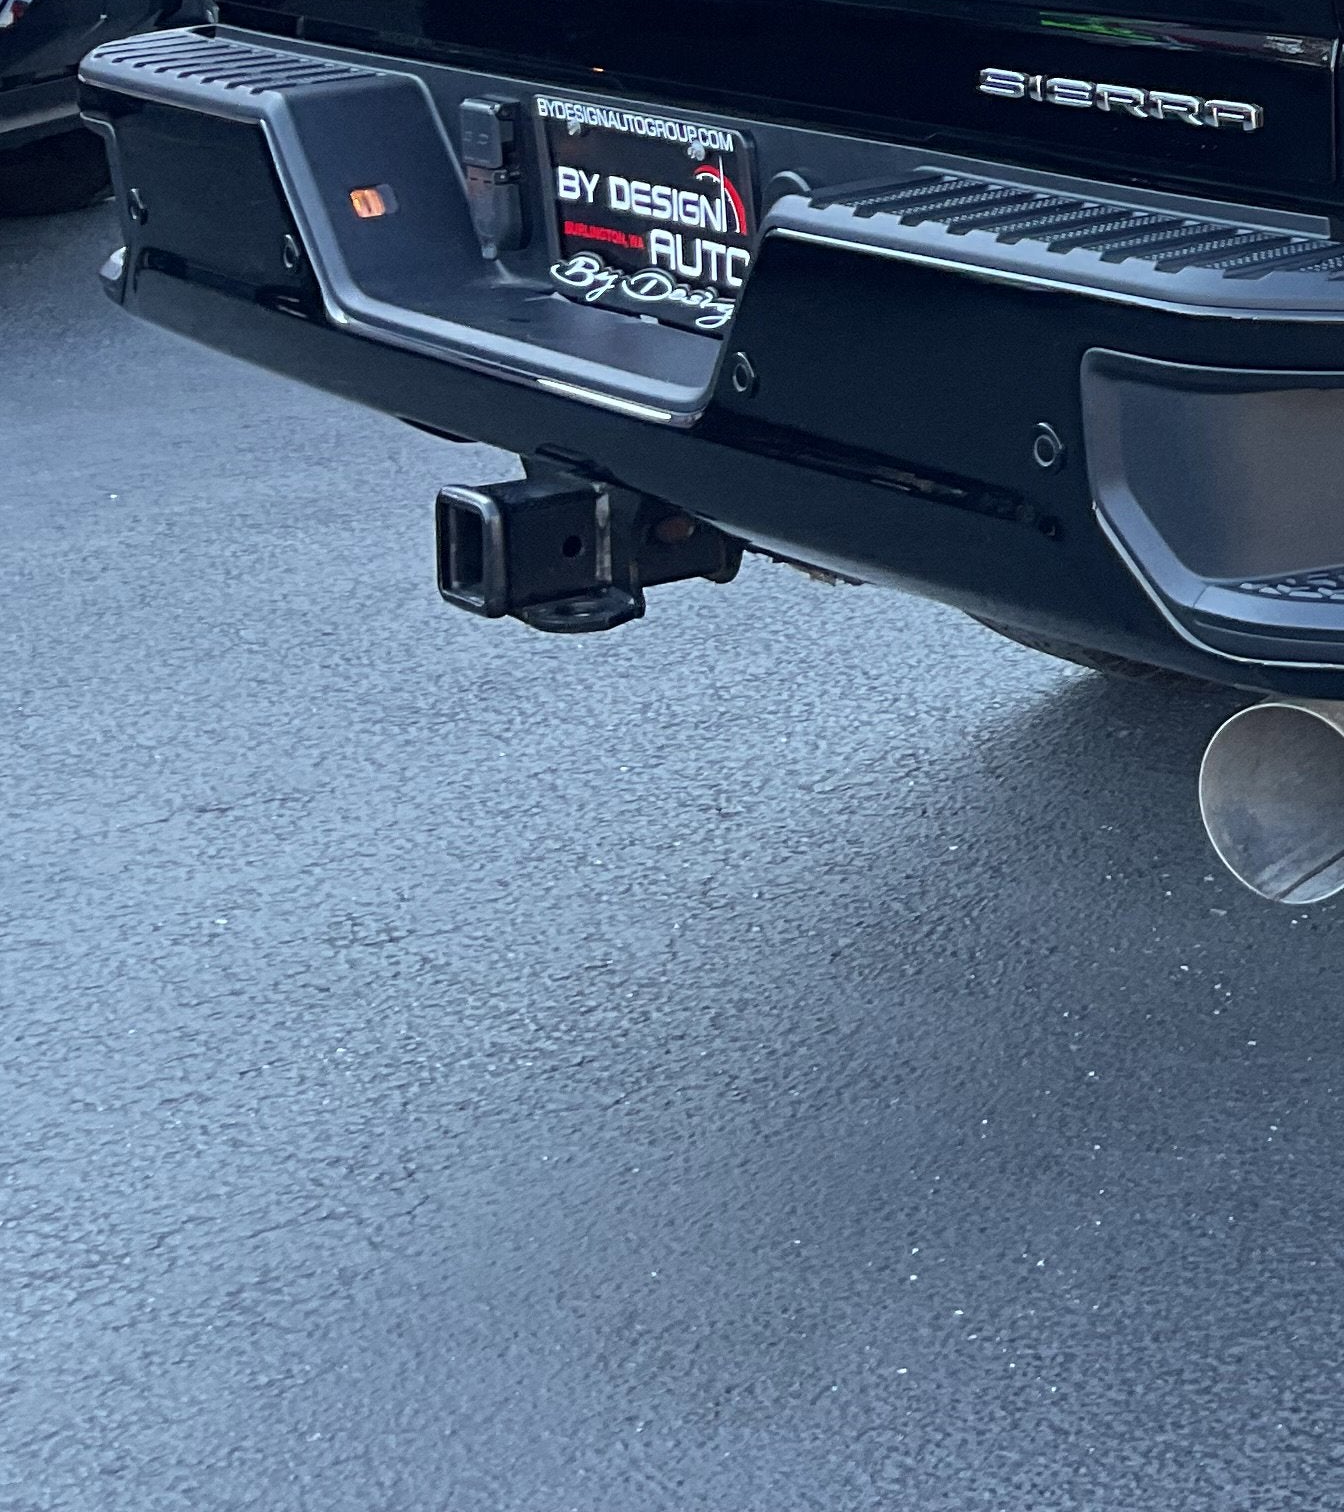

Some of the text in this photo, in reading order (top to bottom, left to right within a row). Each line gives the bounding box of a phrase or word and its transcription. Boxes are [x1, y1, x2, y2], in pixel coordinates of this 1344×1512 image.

[537, 97, 735, 153] BYDESIGNAUTOGROUPCOM
[978, 67, 1264, 131] SIERRA
[557, 165, 727, 233] BY DESIGN
[649, 228, 751, 287] AUTO
[550, 253, 736, 329] By Desig
